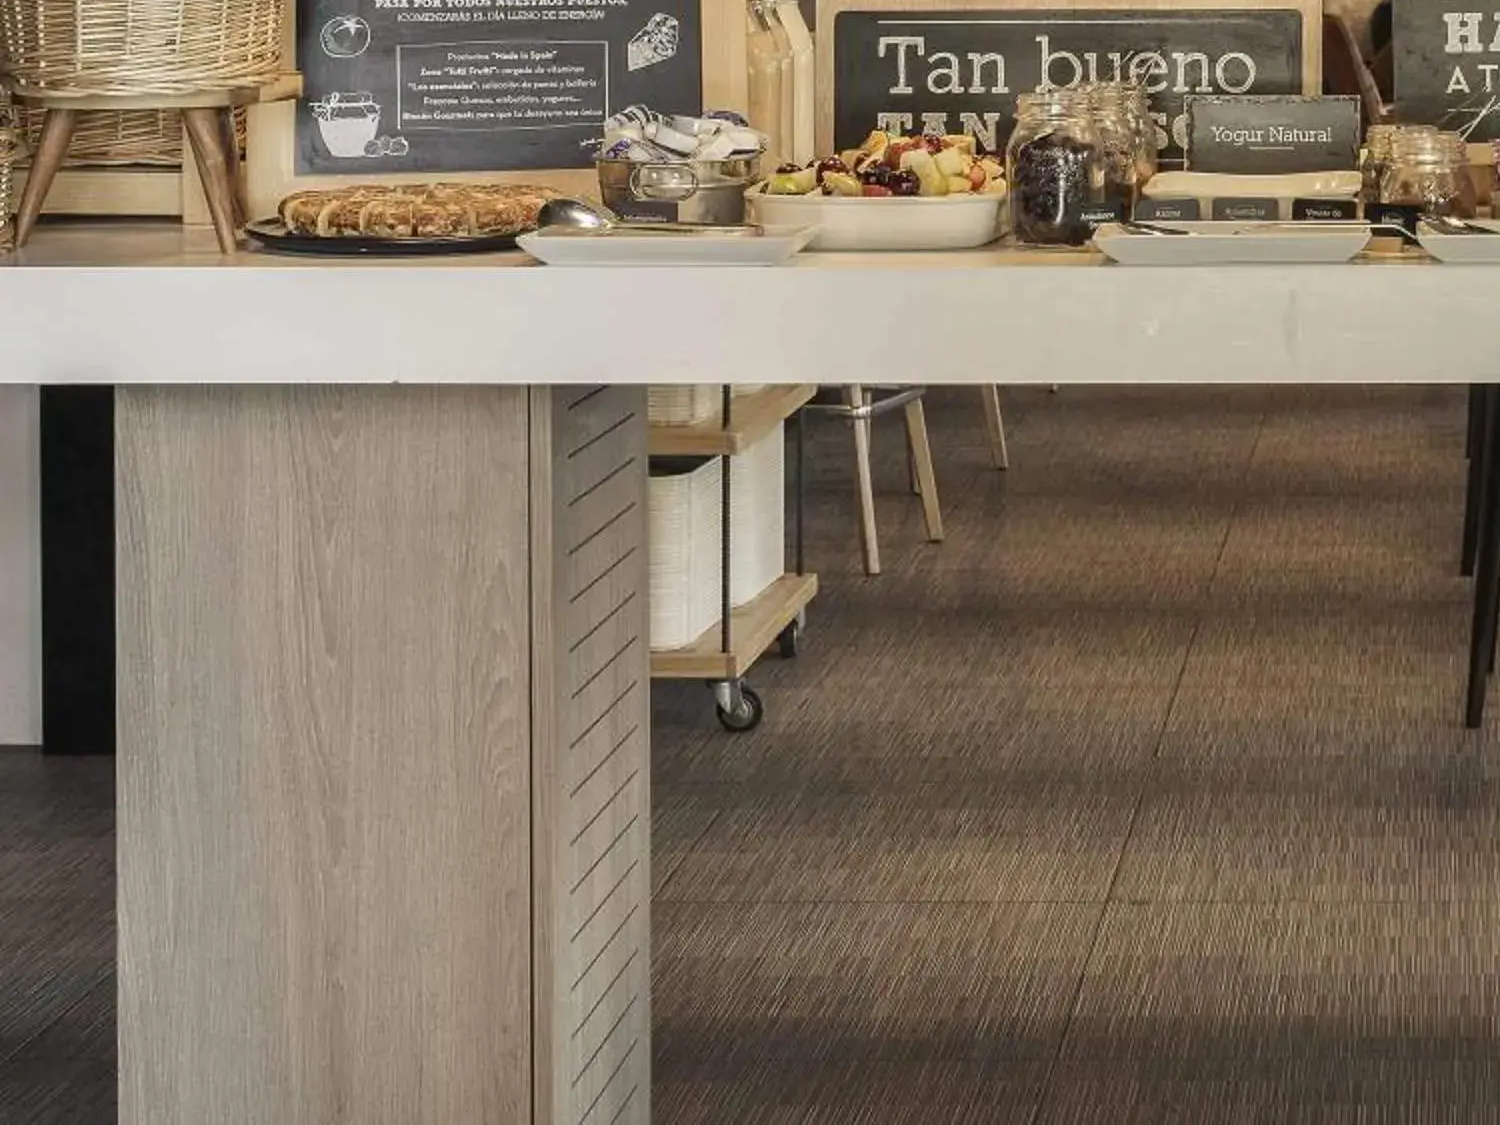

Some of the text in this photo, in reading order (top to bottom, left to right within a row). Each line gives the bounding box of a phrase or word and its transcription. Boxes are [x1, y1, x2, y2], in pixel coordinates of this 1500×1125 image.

[878, 35, 1257, 94] Tan bueno
[1446, 66, 1470, 94] A
[1209, 126, 1265, 146] Yogur
[1268, 126, 1332, 143] Natural
